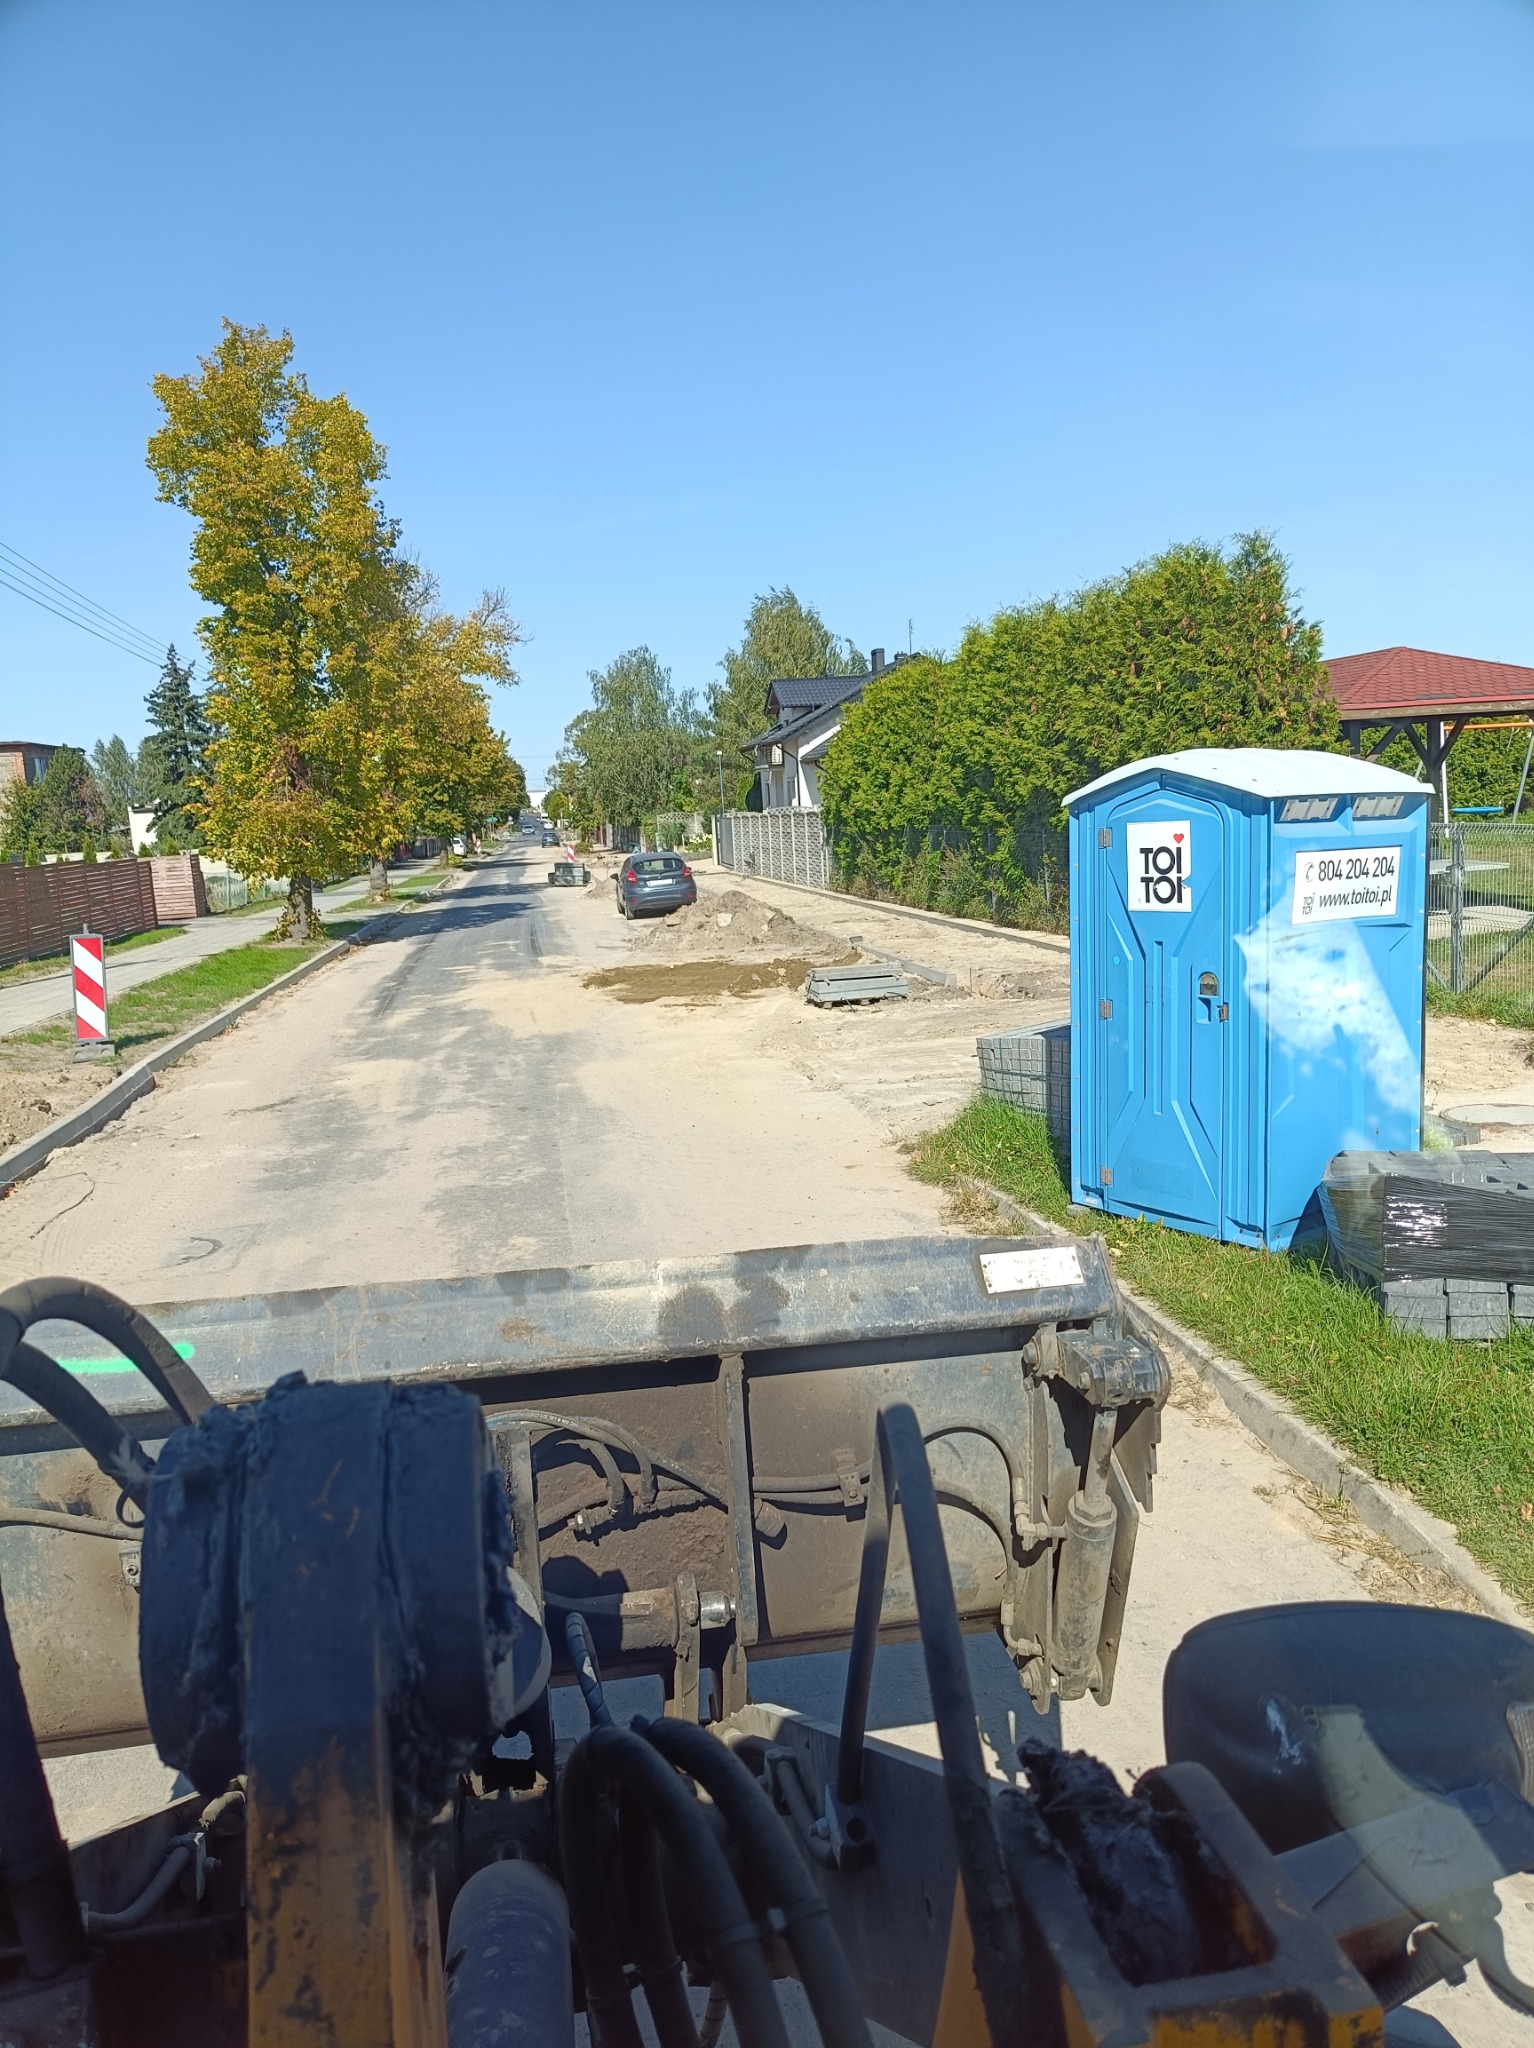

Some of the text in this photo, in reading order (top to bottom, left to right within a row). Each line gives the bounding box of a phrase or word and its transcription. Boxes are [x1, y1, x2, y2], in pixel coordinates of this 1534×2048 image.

[1139, 846, 1182, 875] TOI
[1318, 855, 1395, 881] 804 204 204
[1140, 875, 1183, 904] TOI
[1319, 885, 1393, 908] www.toitoi.pl
